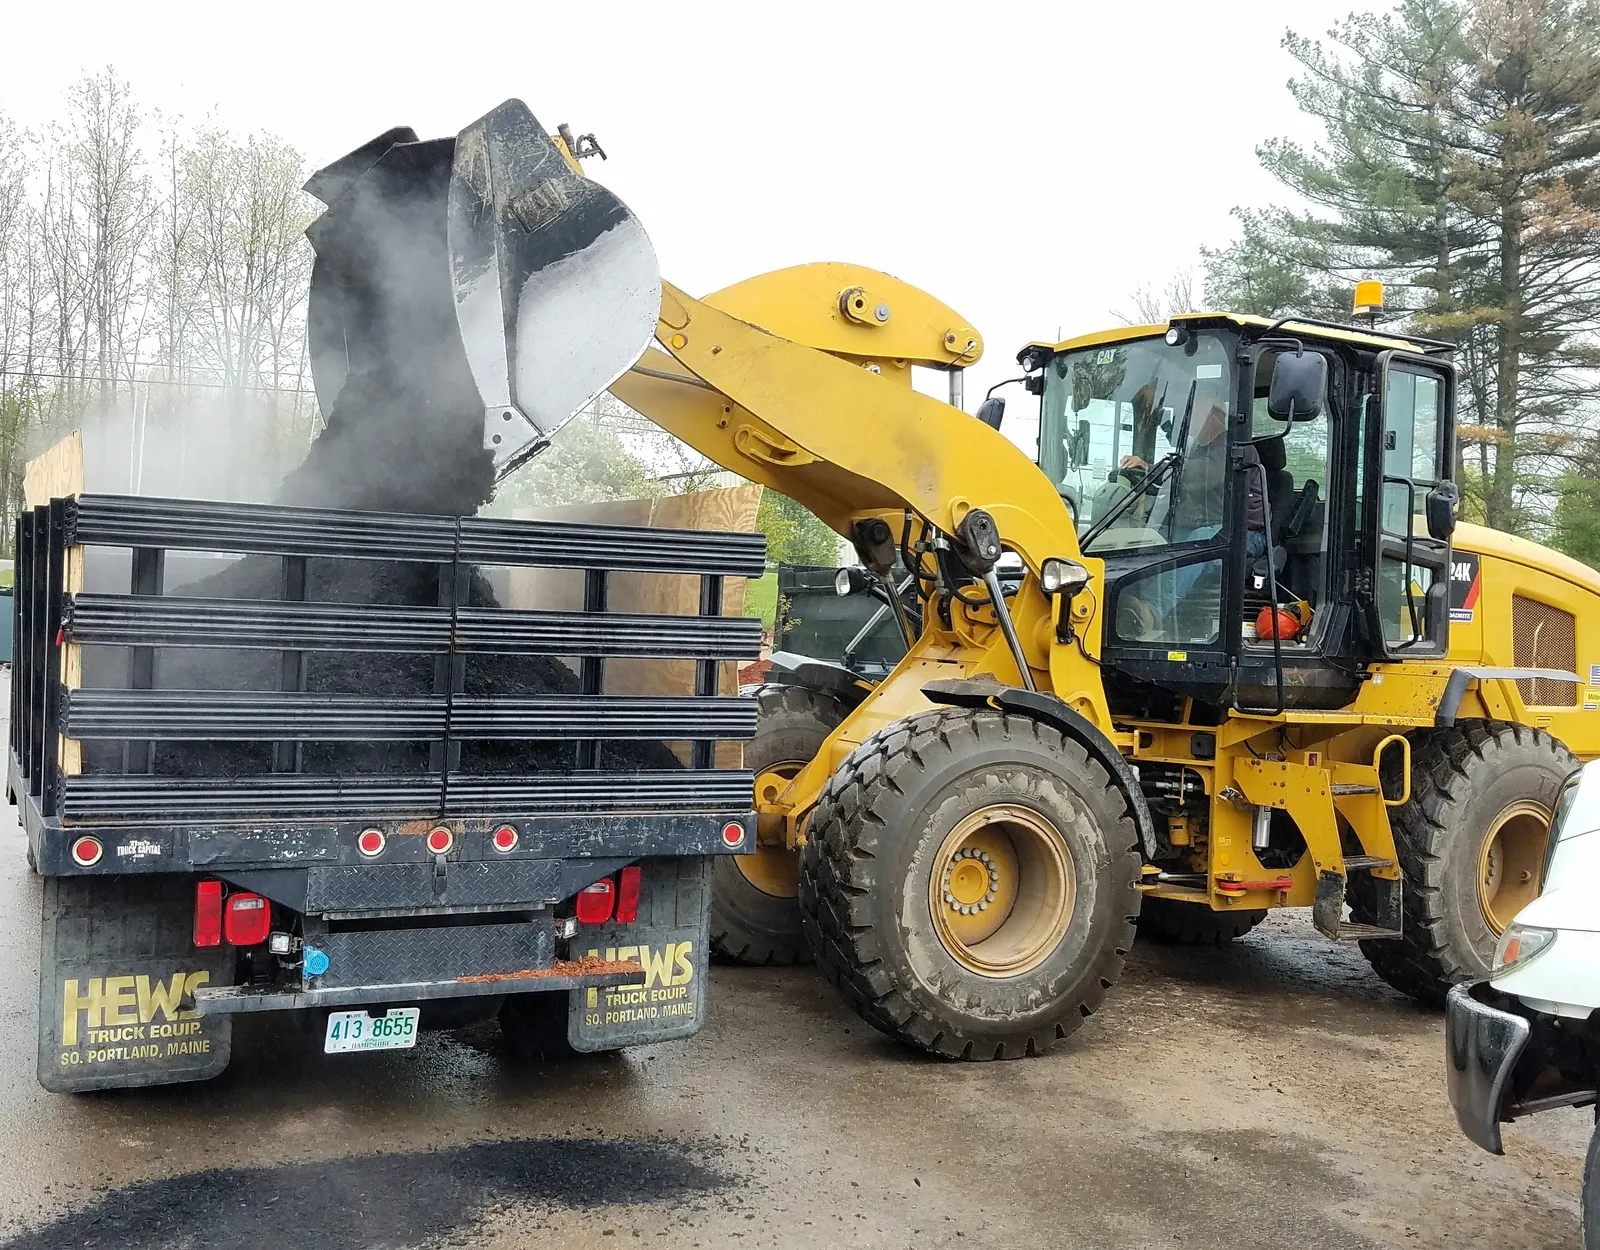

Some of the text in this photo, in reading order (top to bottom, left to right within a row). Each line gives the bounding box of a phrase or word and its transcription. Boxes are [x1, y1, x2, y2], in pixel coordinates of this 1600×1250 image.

[1097, 348, 1117, 365] CAT
[1451, 562, 1471, 582] 24K
[117, 844, 161, 857] TRUCK CAPITAL
[62, 970, 210, 1046] HEWS
[606, 987, 688, 1007] TRUCK EQUIP.
[585, 1003, 693, 1026] SO. PORTLAND, MAINE
[88, 1021, 203, 1044] TRUCK EQUIP.
[330, 1016, 414, 1040] 413 8655
[60, 1039, 211, 1066] SO. PORTLAND, MAINE
